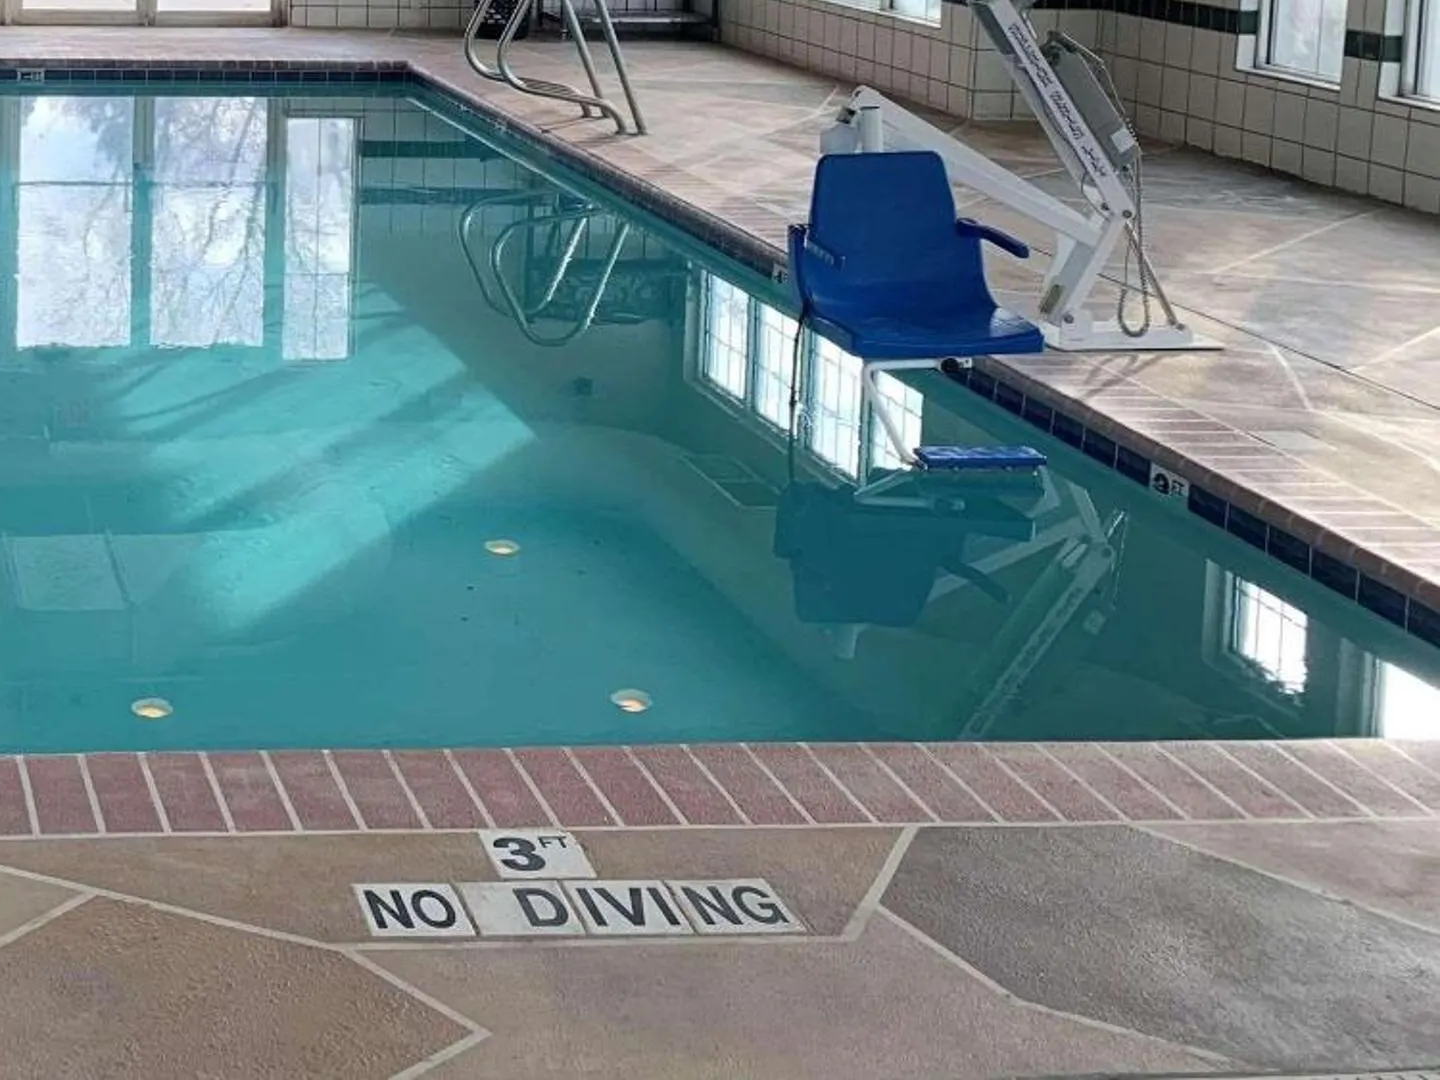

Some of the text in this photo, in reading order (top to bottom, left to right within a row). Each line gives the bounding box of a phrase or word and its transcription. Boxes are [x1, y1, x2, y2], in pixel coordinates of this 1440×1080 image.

[493, 835, 568, 871] 3 FT
[364, 885, 790, 930] NO DIVING
